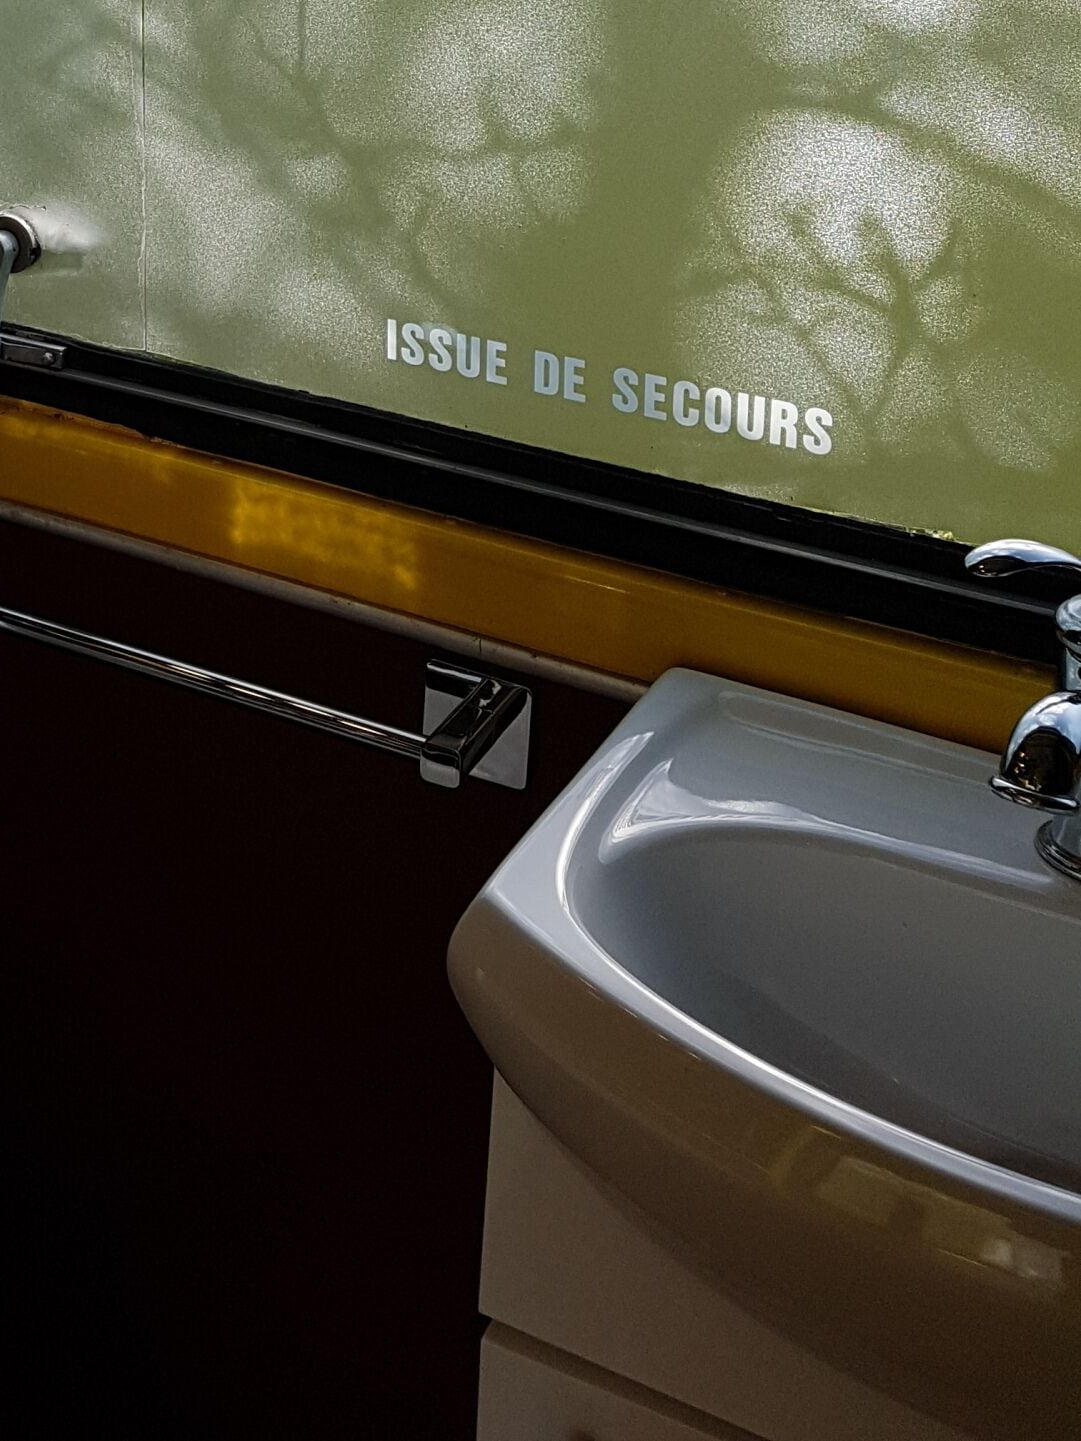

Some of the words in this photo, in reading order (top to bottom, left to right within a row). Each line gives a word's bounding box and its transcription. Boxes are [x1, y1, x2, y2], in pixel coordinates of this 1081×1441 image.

[386, 318, 508, 386] ISSUE
[533, 350, 587, 403] DE
[611, 367, 834, 455] SECOURS
